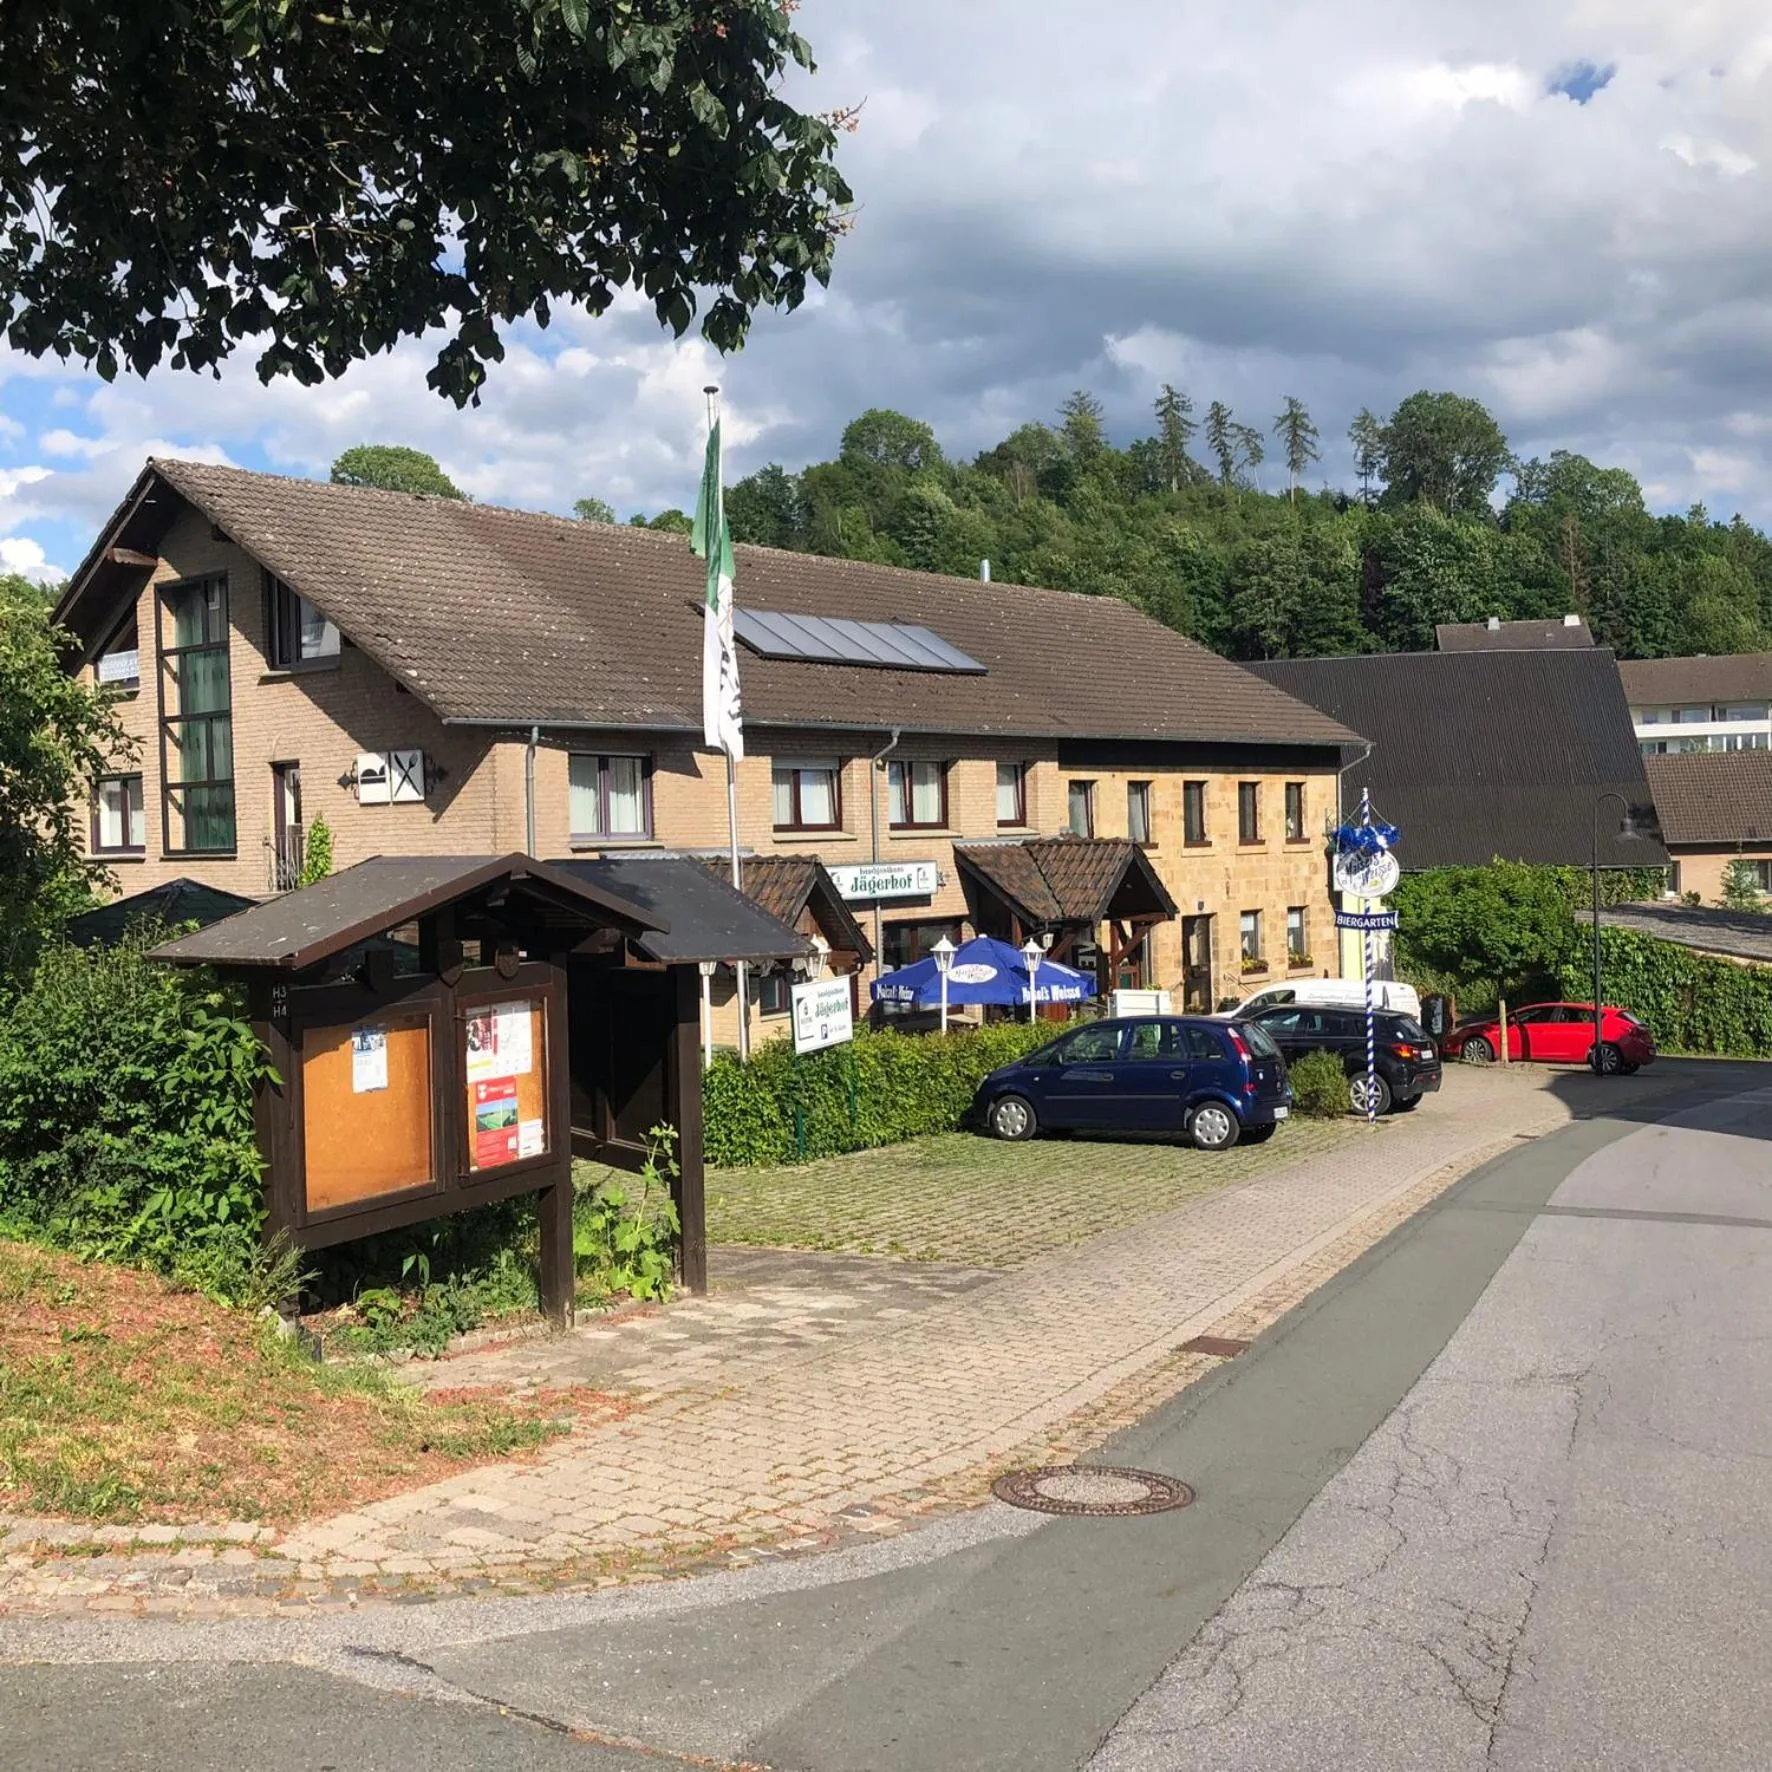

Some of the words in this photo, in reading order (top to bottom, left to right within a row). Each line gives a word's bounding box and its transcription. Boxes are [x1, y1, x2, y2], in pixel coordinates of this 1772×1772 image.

[851, 874, 913, 894] Jägerhof
[1337, 915, 1394, 927] BIERGARTEN
[273, 986, 287, 999] H3
[273, 1004, 287, 1018] H4
